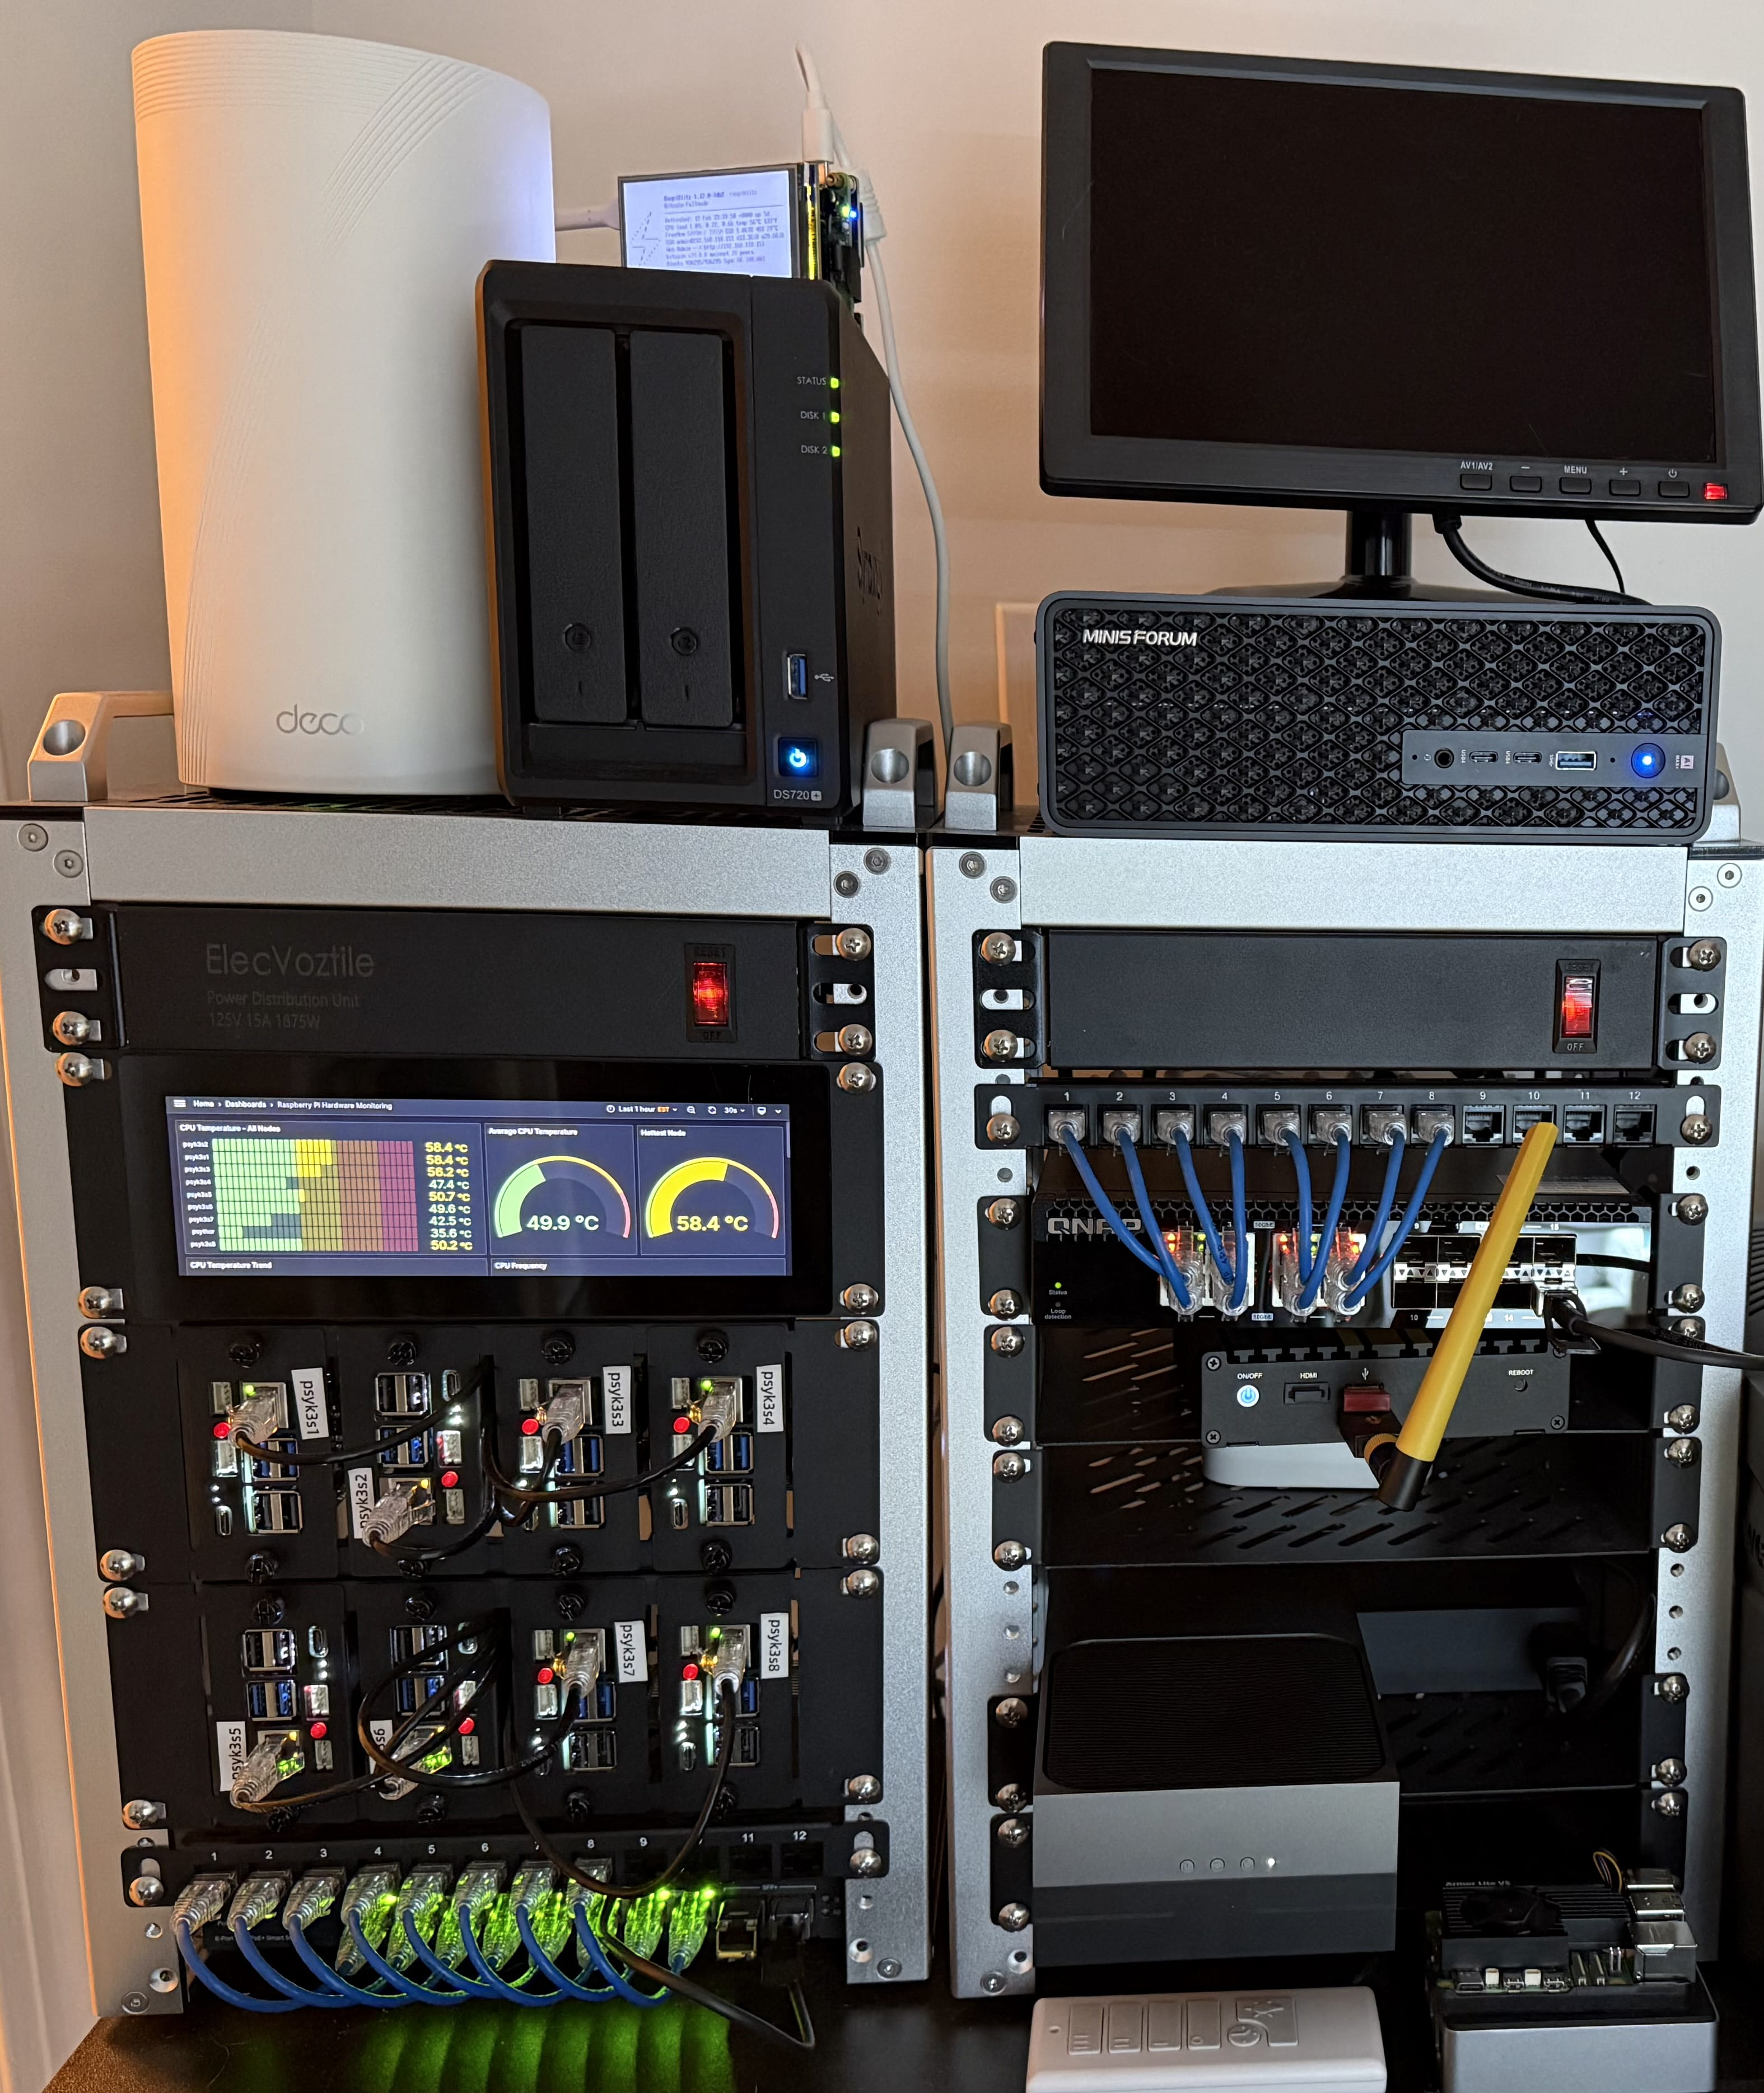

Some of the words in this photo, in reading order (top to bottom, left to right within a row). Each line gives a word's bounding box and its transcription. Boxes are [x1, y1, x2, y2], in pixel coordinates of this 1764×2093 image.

[797, 376, 827, 385] STATUS
[800, 411, 819, 419] DISK
[801, 445, 819, 454] DISK
[1460, 462, 1494, 471] AV1/AV2
[1564, 465, 1588, 475] MENU
[1082, 629, 1197, 646] MINISFORUM
[276, 704, 364, 735] deco
[207, 943, 375, 977] ElecVoztile
[208, 990, 248, 1004] Power
[253, 991, 329, 1008] Distribution
[333, 993, 360, 1008] Unit
[1567, 1043, 1584, 1052] OFF
[1064, 1092, 1070, 1101] 1
[1117, 1092, 1123, 1101] 2
[1169, 1092, 1175, 1101] 3
[1222, 1092, 1228, 1100] 4
[1275, 1092, 1280, 1101] 5
[1326, 1092, 1332, 1100] 6
[1378, 1092, 1383, 1100] 7
[1429, 1092, 1435, 1100] 8
[1480, 1092, 1486, 1100] 9
[1528, 1091, 1540, 1100] 10
[1581, 1091, 1590, 1100] 11
[1629, 1091, 1641, 1100] 12
[277, 1101, 312, 1110] Raspberry
[198, 1124, 241, 1133] Temperature
[426, 1142, 453, 1152] 58.4
[426, 1155, 454, 1165] 58.4
[427, 1167, 454, 1177] 56.2
[428, 1179, 455, 1189] 47.4
[428, 1192, 455, 1202] 50.7
[428, 1204, 456, 1213] 49.6
[429, 1216, 457, 1226] 42.5
[527, 1216, 570, 1231] 49.9
[575, 1216, 599, 1231] °C
[677, 1216, 720, 1231] 58.4
[725, 1216, 748, 1231] °C
[430, 1228, 458, 1238] 35.6
[431, 1240, 458, 1250] 50.2
[511, 1263, 547, 1271] Frequency
[608, 1372, 624, 1427] psyk3s3
[761, 1371, 775, 1425] psyk3s4
[300, 1381, 319, 1435] psyk3s1
[620, 1624, 635, 1676] psyk3s7
[768, 1619, 781, 1672] psyk3s8
[212, 1852, 217, 1861] 1
[265, 1850, 273, 1860] 2
[320, 1849, 328, 1858] 3
[375, 1847, 381, 1856] 4
[428, 1844, 435, 1854] 5
[482, 1843, 489, 1852] 6
[587, 1839, 595, 1848] 8
[640, 1837, 647, 1847] 9
[743, 1833, 754, 1843] 11
[794, 1832, 807, 1840] 12
